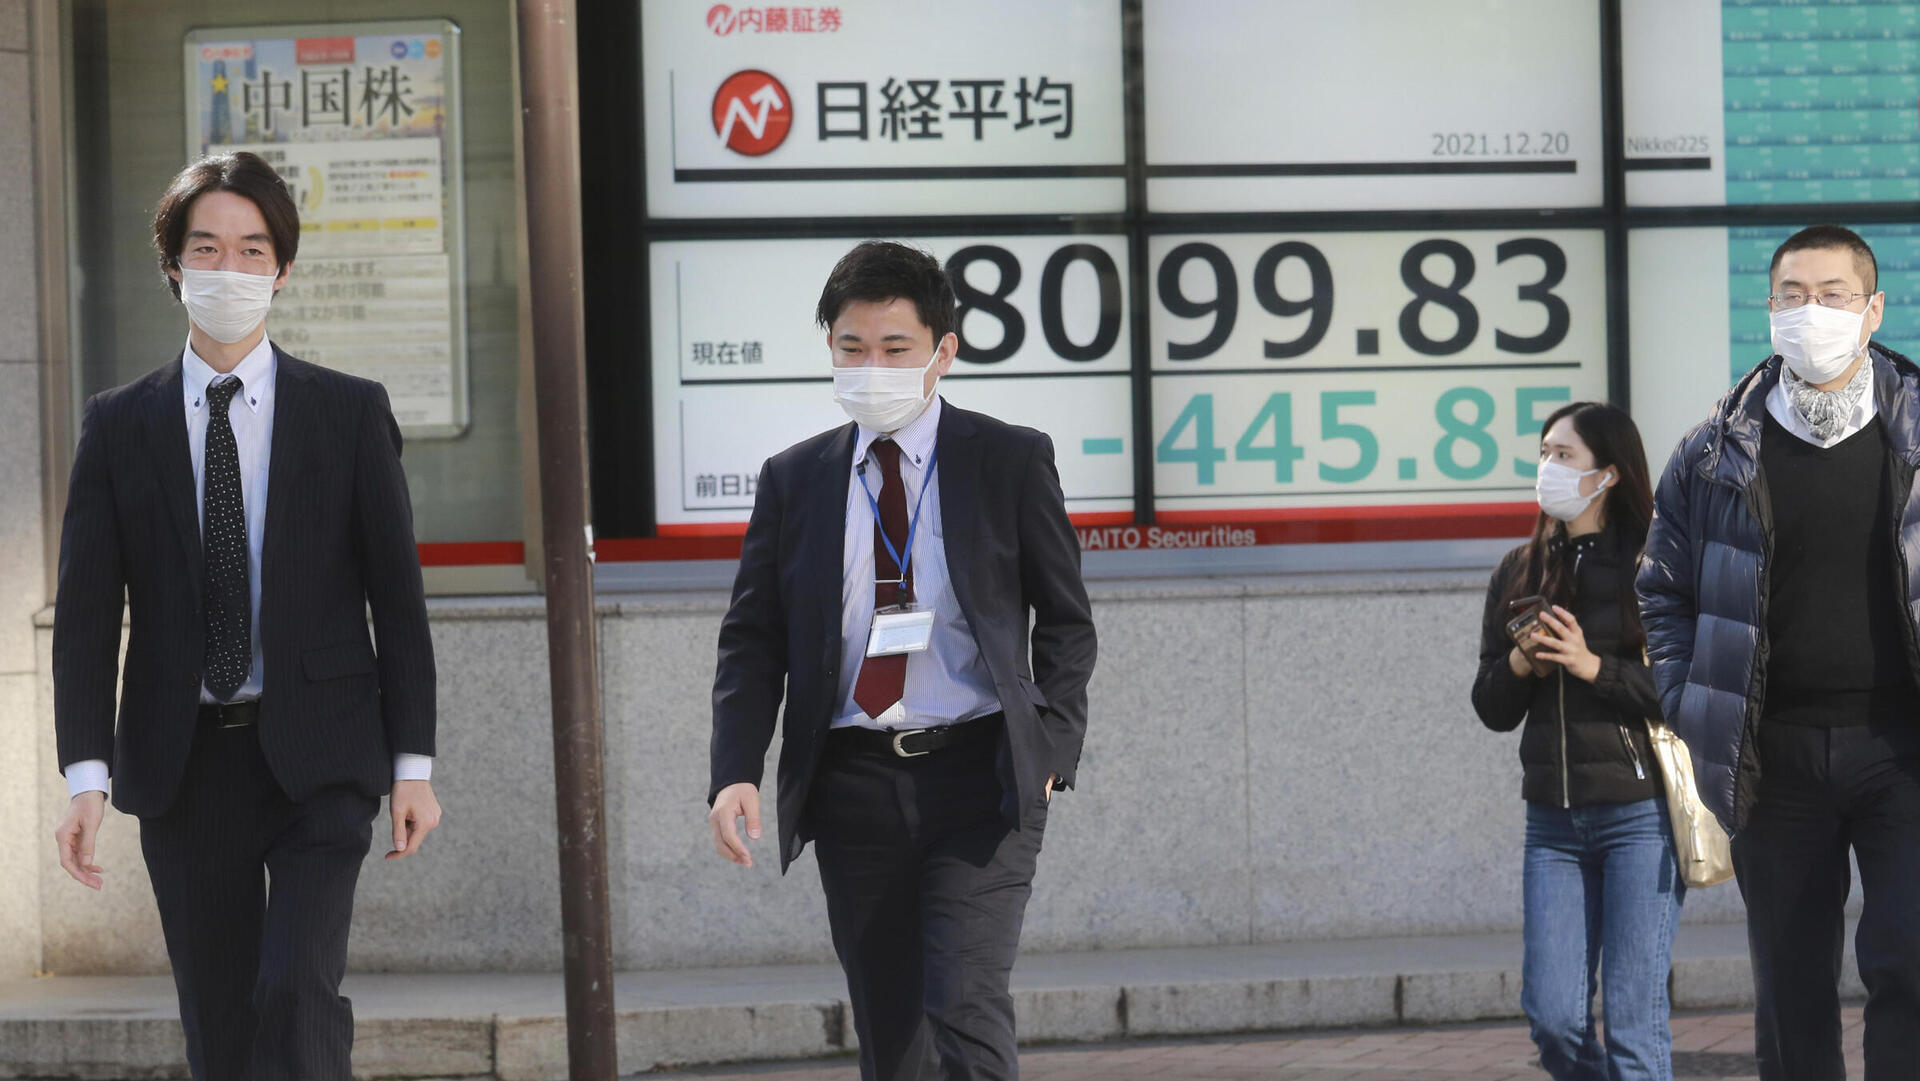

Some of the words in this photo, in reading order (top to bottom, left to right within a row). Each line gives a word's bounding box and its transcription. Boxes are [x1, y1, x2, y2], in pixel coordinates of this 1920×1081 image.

[738, 7, 843, 34] 内藤証券
[243, 65, 415, 130] 中国株
[816, 77, 1074, 142] 日経平均
[1431, 132, 1570, 156] 2021.12.20
[1627, 136, 1710, 154] Nikkei225
[692, 341, 764, 365] 現在値
[1147, 526, 1256, 548] Securities
